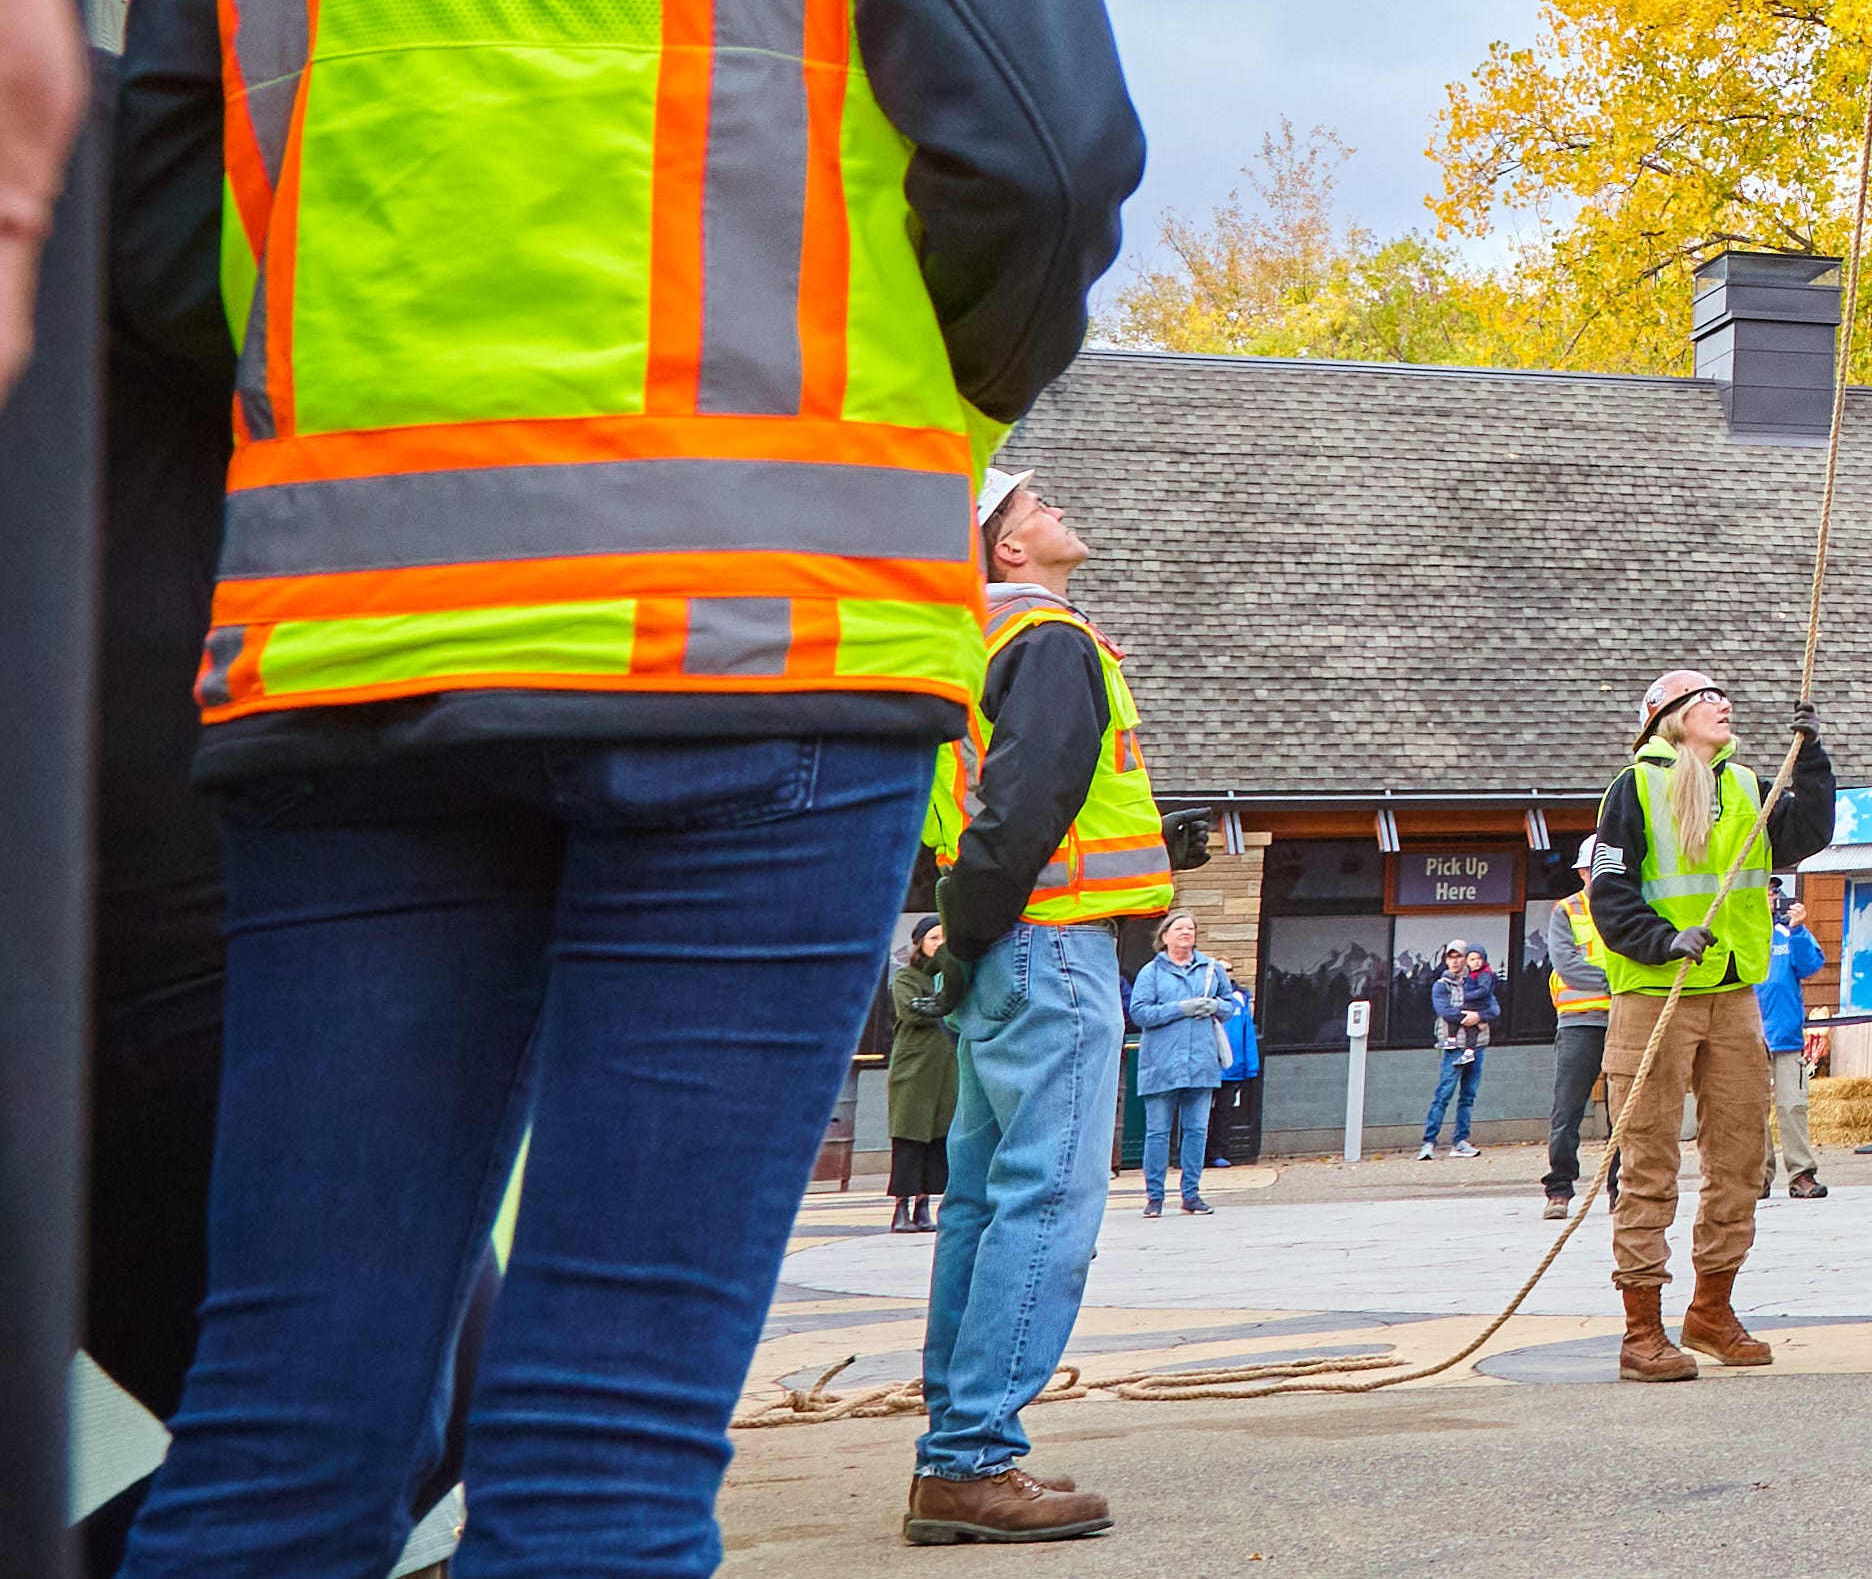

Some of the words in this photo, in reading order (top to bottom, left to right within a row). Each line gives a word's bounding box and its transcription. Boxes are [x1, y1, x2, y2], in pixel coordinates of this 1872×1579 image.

[1426, 857, 1461, 876] Pick
[1465, 857, 1489, 880] Up
[1436, 882, 1477, 900] Here
